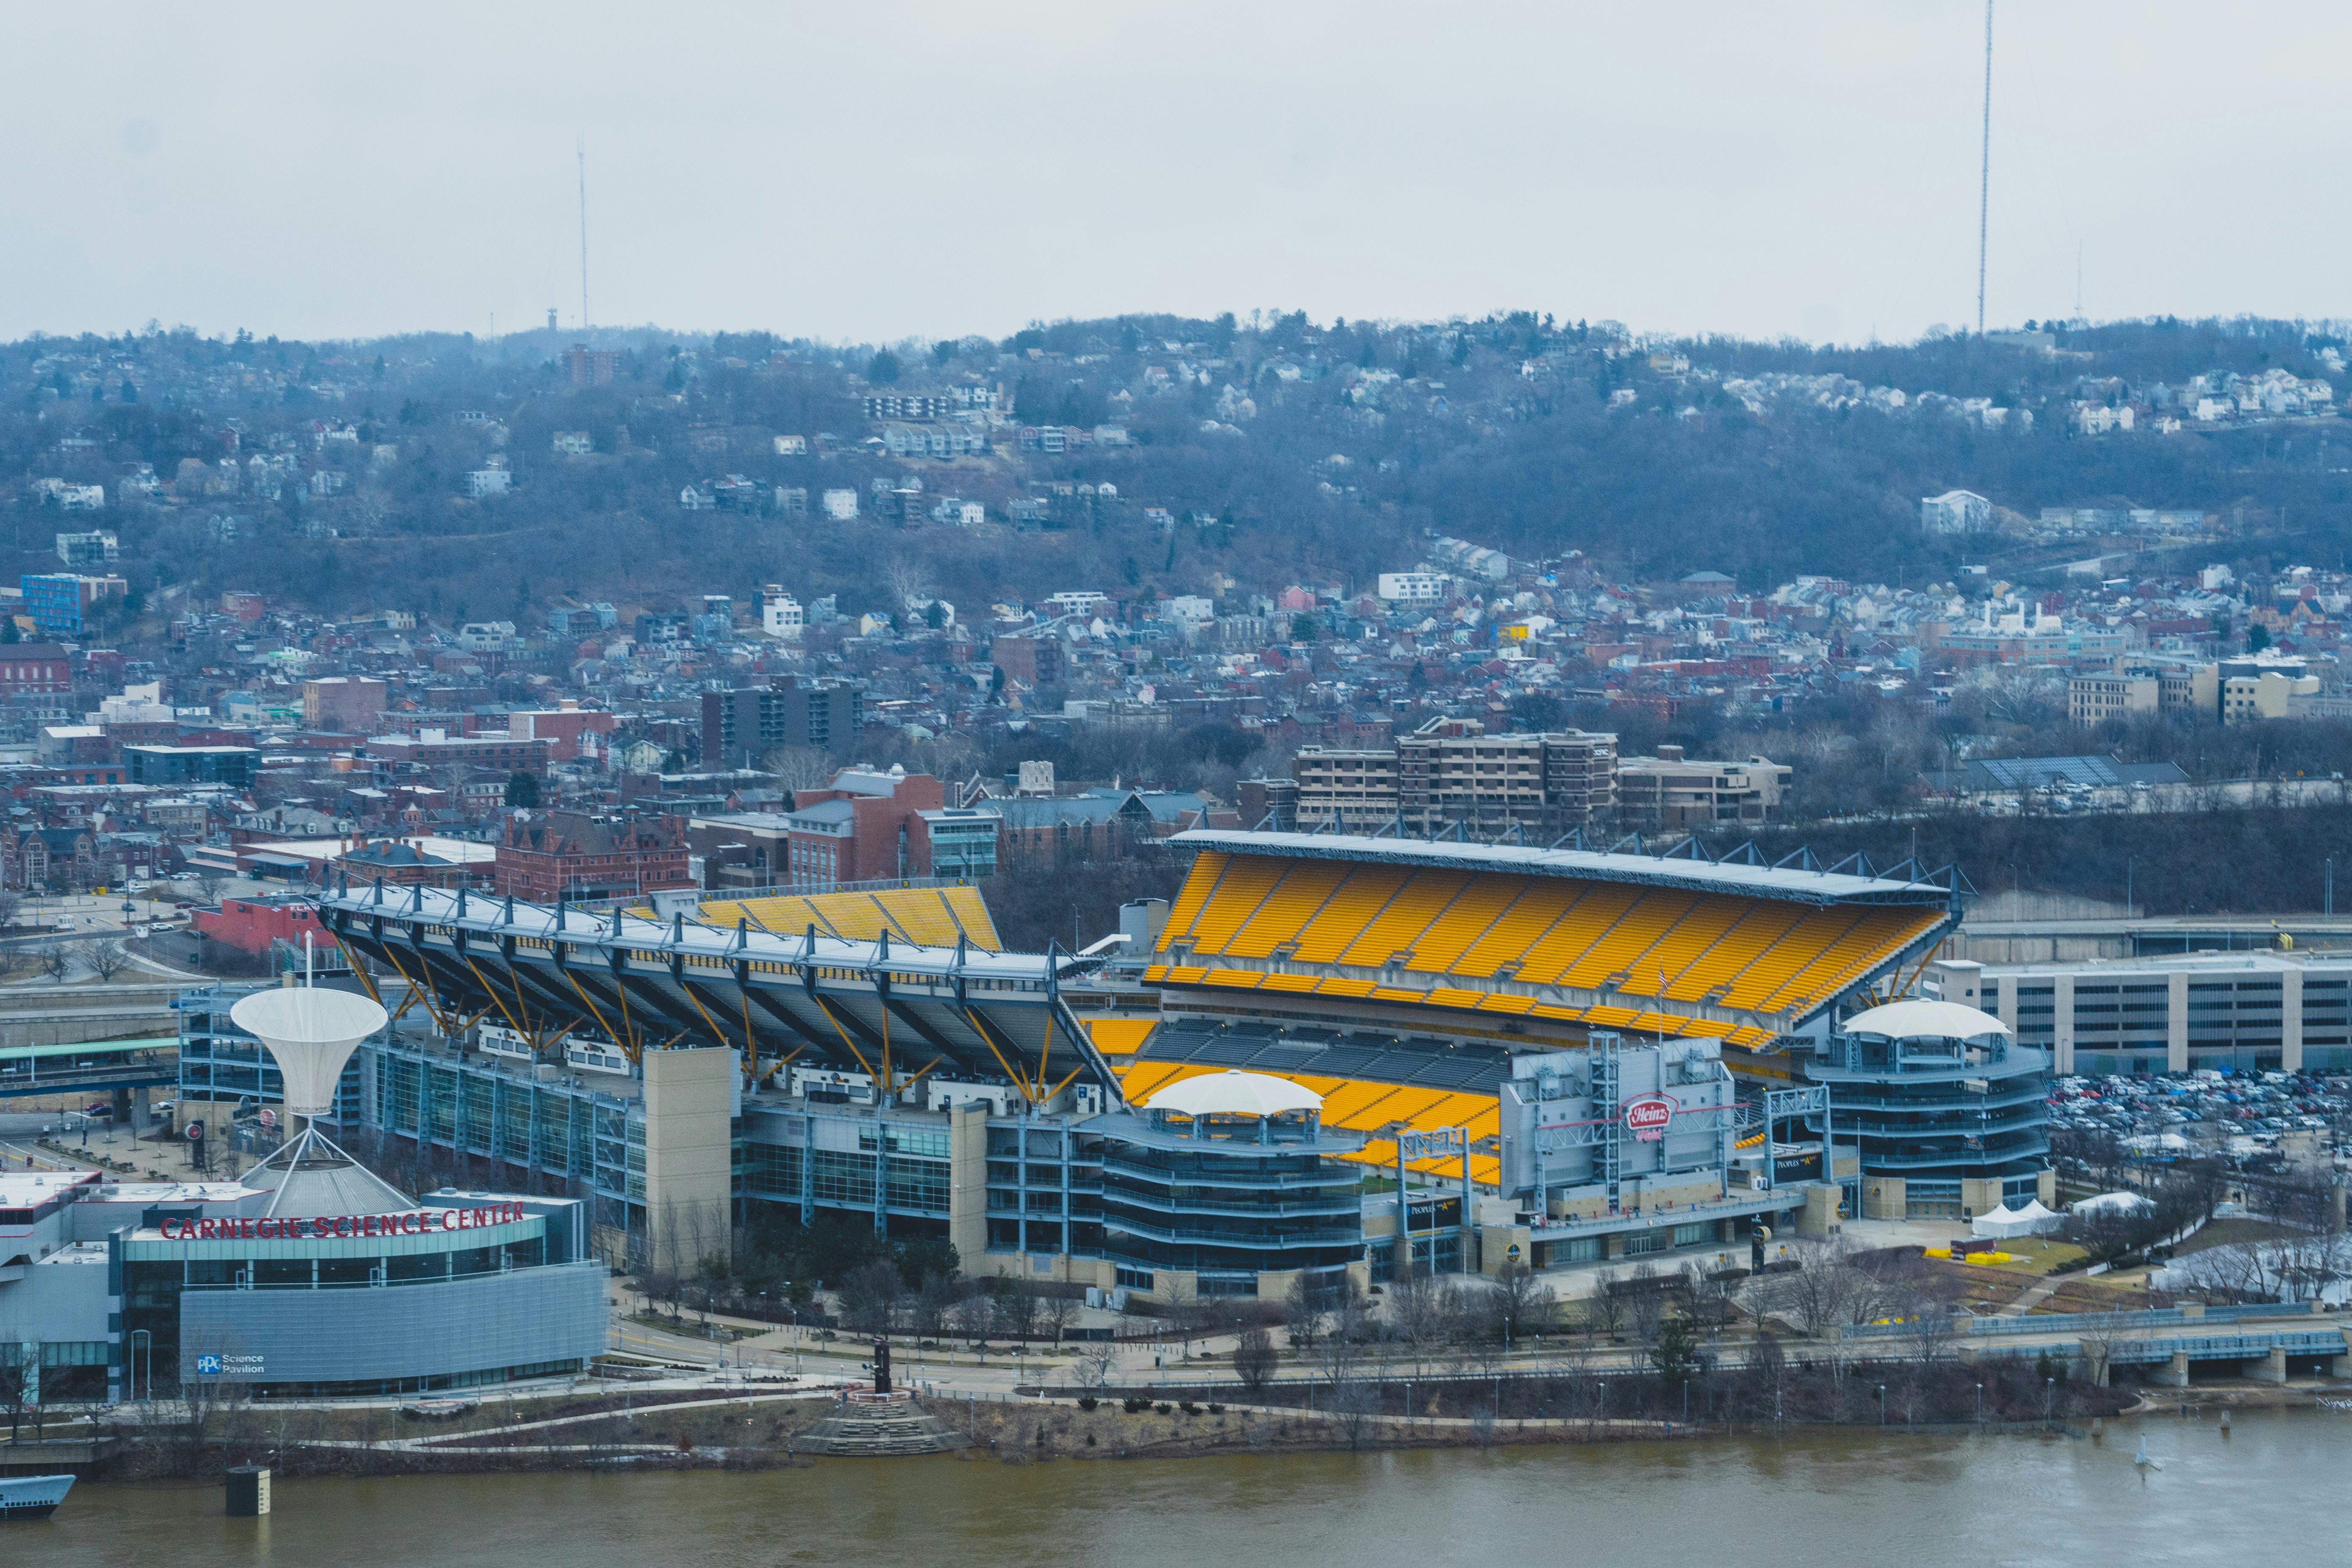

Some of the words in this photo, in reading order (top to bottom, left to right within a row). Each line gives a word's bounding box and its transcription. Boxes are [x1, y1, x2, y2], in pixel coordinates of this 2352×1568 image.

[1631, 1106, 1667, 1123] Heinz
[1777, 1159, 1800, 1169] PEOPLES
[1411, 1205, 1436, 1215] PEOPLES
[161, 1217, 302, 1239] CARNEGIE
[313, 1212, 432, 1238] SCIENCE
[442, 1201, 524, 1231] CENTER
[222, 1354, 264, 1363] Science
[198, 1356, 221, 1373] PPG
[222, 1365, 264, 1373] Pavilion
